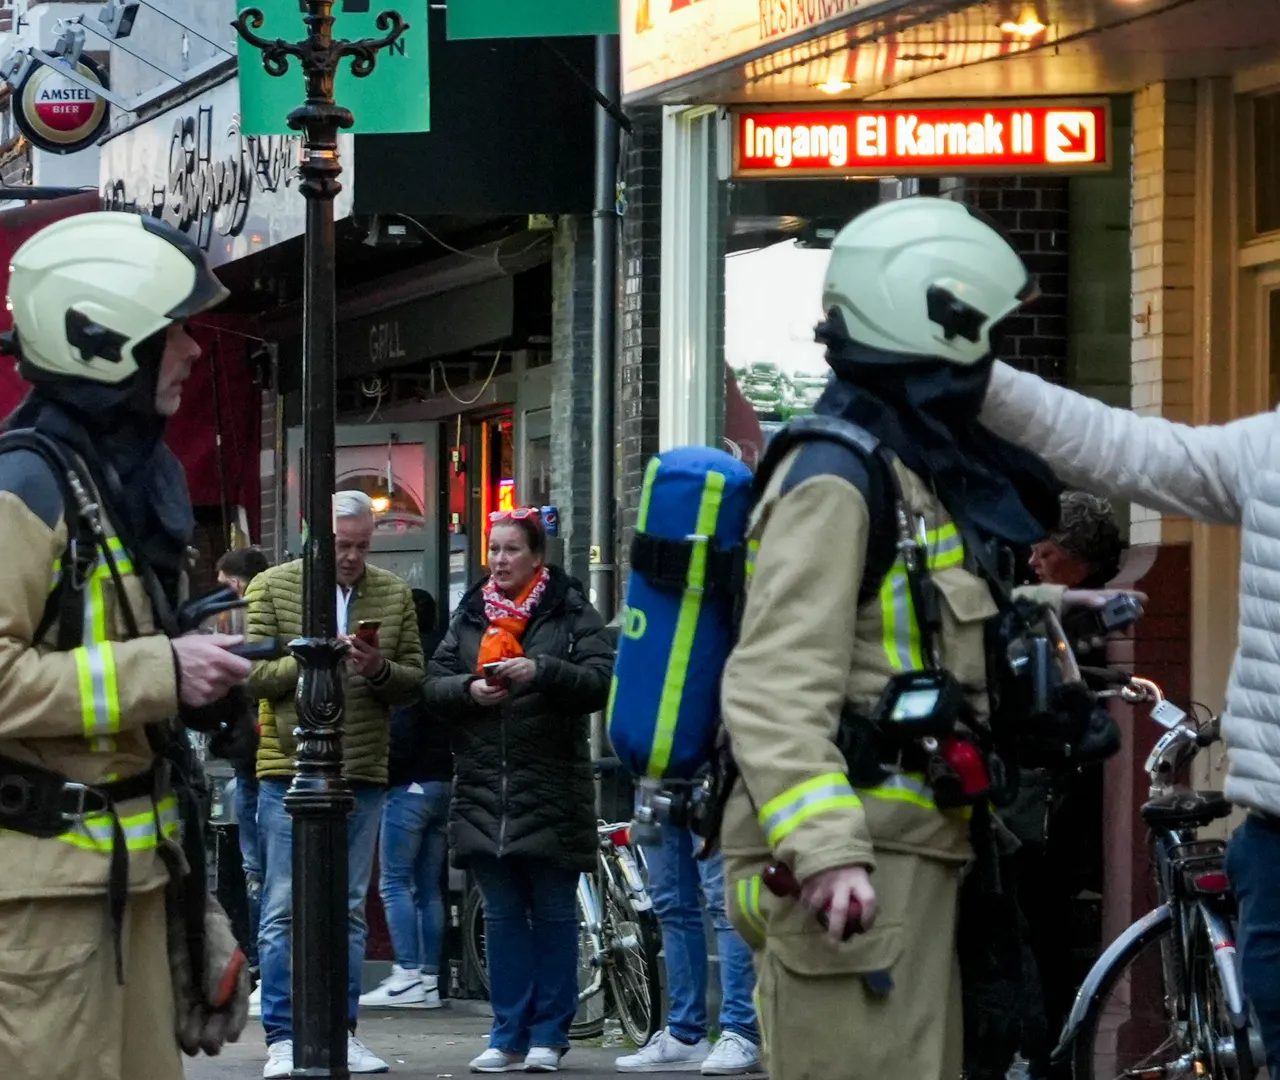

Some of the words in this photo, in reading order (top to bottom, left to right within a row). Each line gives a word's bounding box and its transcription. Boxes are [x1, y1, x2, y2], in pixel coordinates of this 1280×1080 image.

[41, 88, 92, 100] AMSTEL
[52, 105, 80, 113] BIER
[745, 116, 848, 167] Ingang
[895, 112, 1004, 156] Karnak
